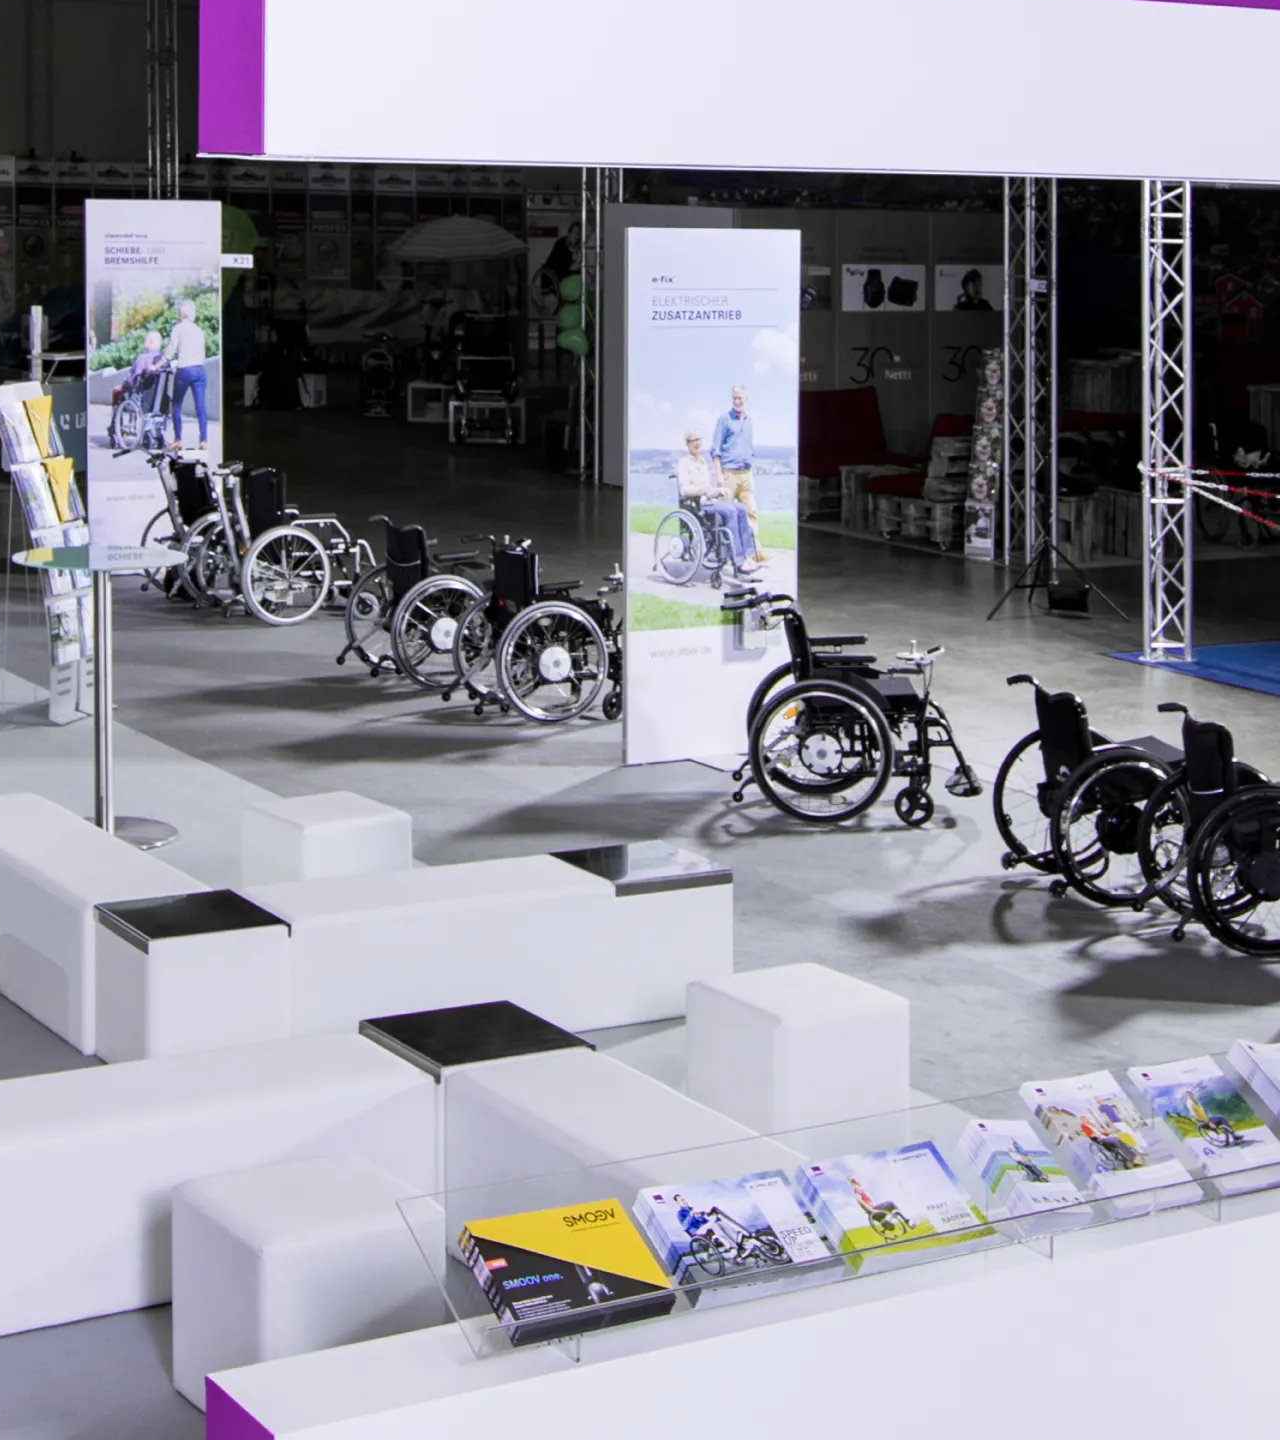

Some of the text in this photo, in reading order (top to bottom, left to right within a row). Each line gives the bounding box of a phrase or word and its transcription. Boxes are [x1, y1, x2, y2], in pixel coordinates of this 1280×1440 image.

[104, 256, 159, 265] BREMSHILFE
[651, 295, 729, 307] ELEKTRISCHER
[651, 310, 742, 321] ZUSATZANTRIEB
[884, 368, 913, 381] Netti
[779, 1226, 813, 1239] SPEED
[784, 1236, 798, 1247] UP
[502, 1272, 564, 1291] SMOOV one.
